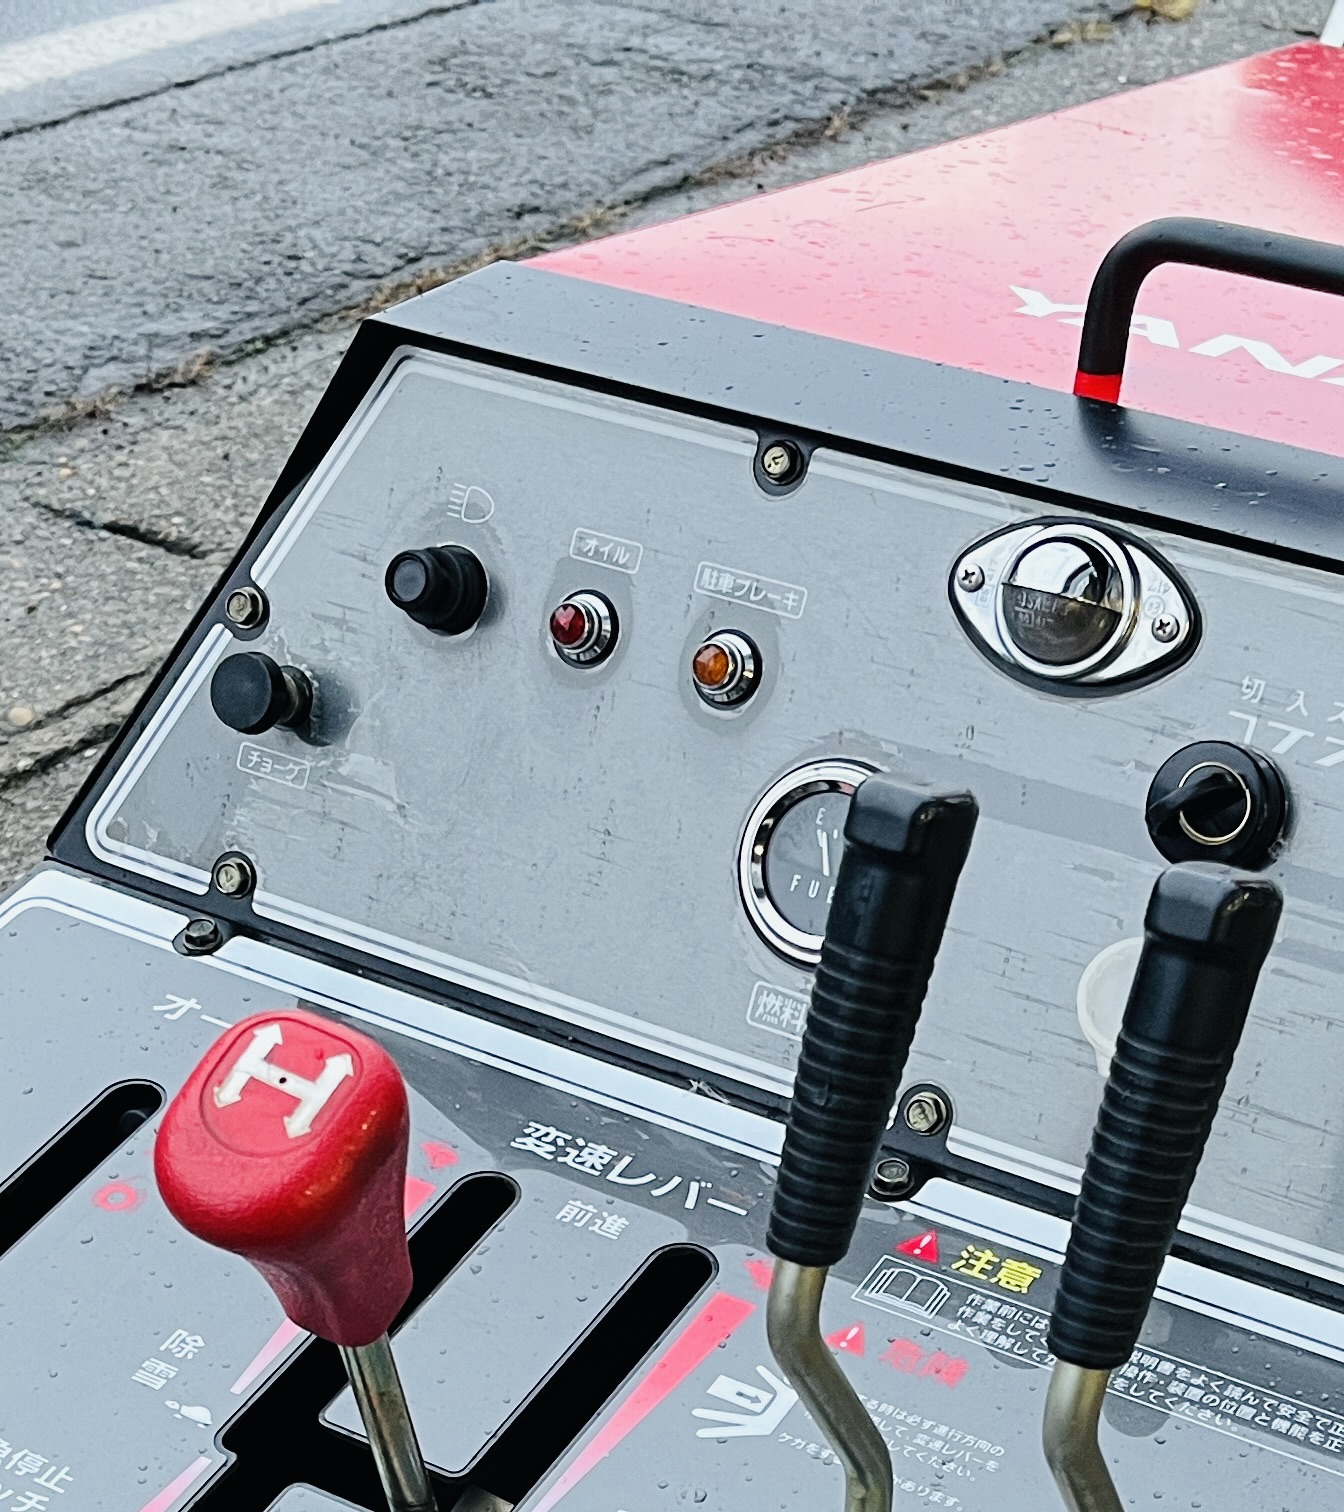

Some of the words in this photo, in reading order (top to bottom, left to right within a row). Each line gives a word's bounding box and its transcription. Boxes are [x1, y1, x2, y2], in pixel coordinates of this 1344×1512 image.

[582, 538, 630, 565] オイル
[701, 568, 799, 611] 駐車ブレーキ
[1241, 675, 1265, 704] 切
[1286, 690, 1308, 716] 入
[790, 874, 836, 904] FUE
[510, 1121, 748, 1216] 変速レバー
[555, 1199, 630, 1241] 前進
[951, 1244, 1044, 1294] 注意
[131, 1328, 206, 1391] 除雪
